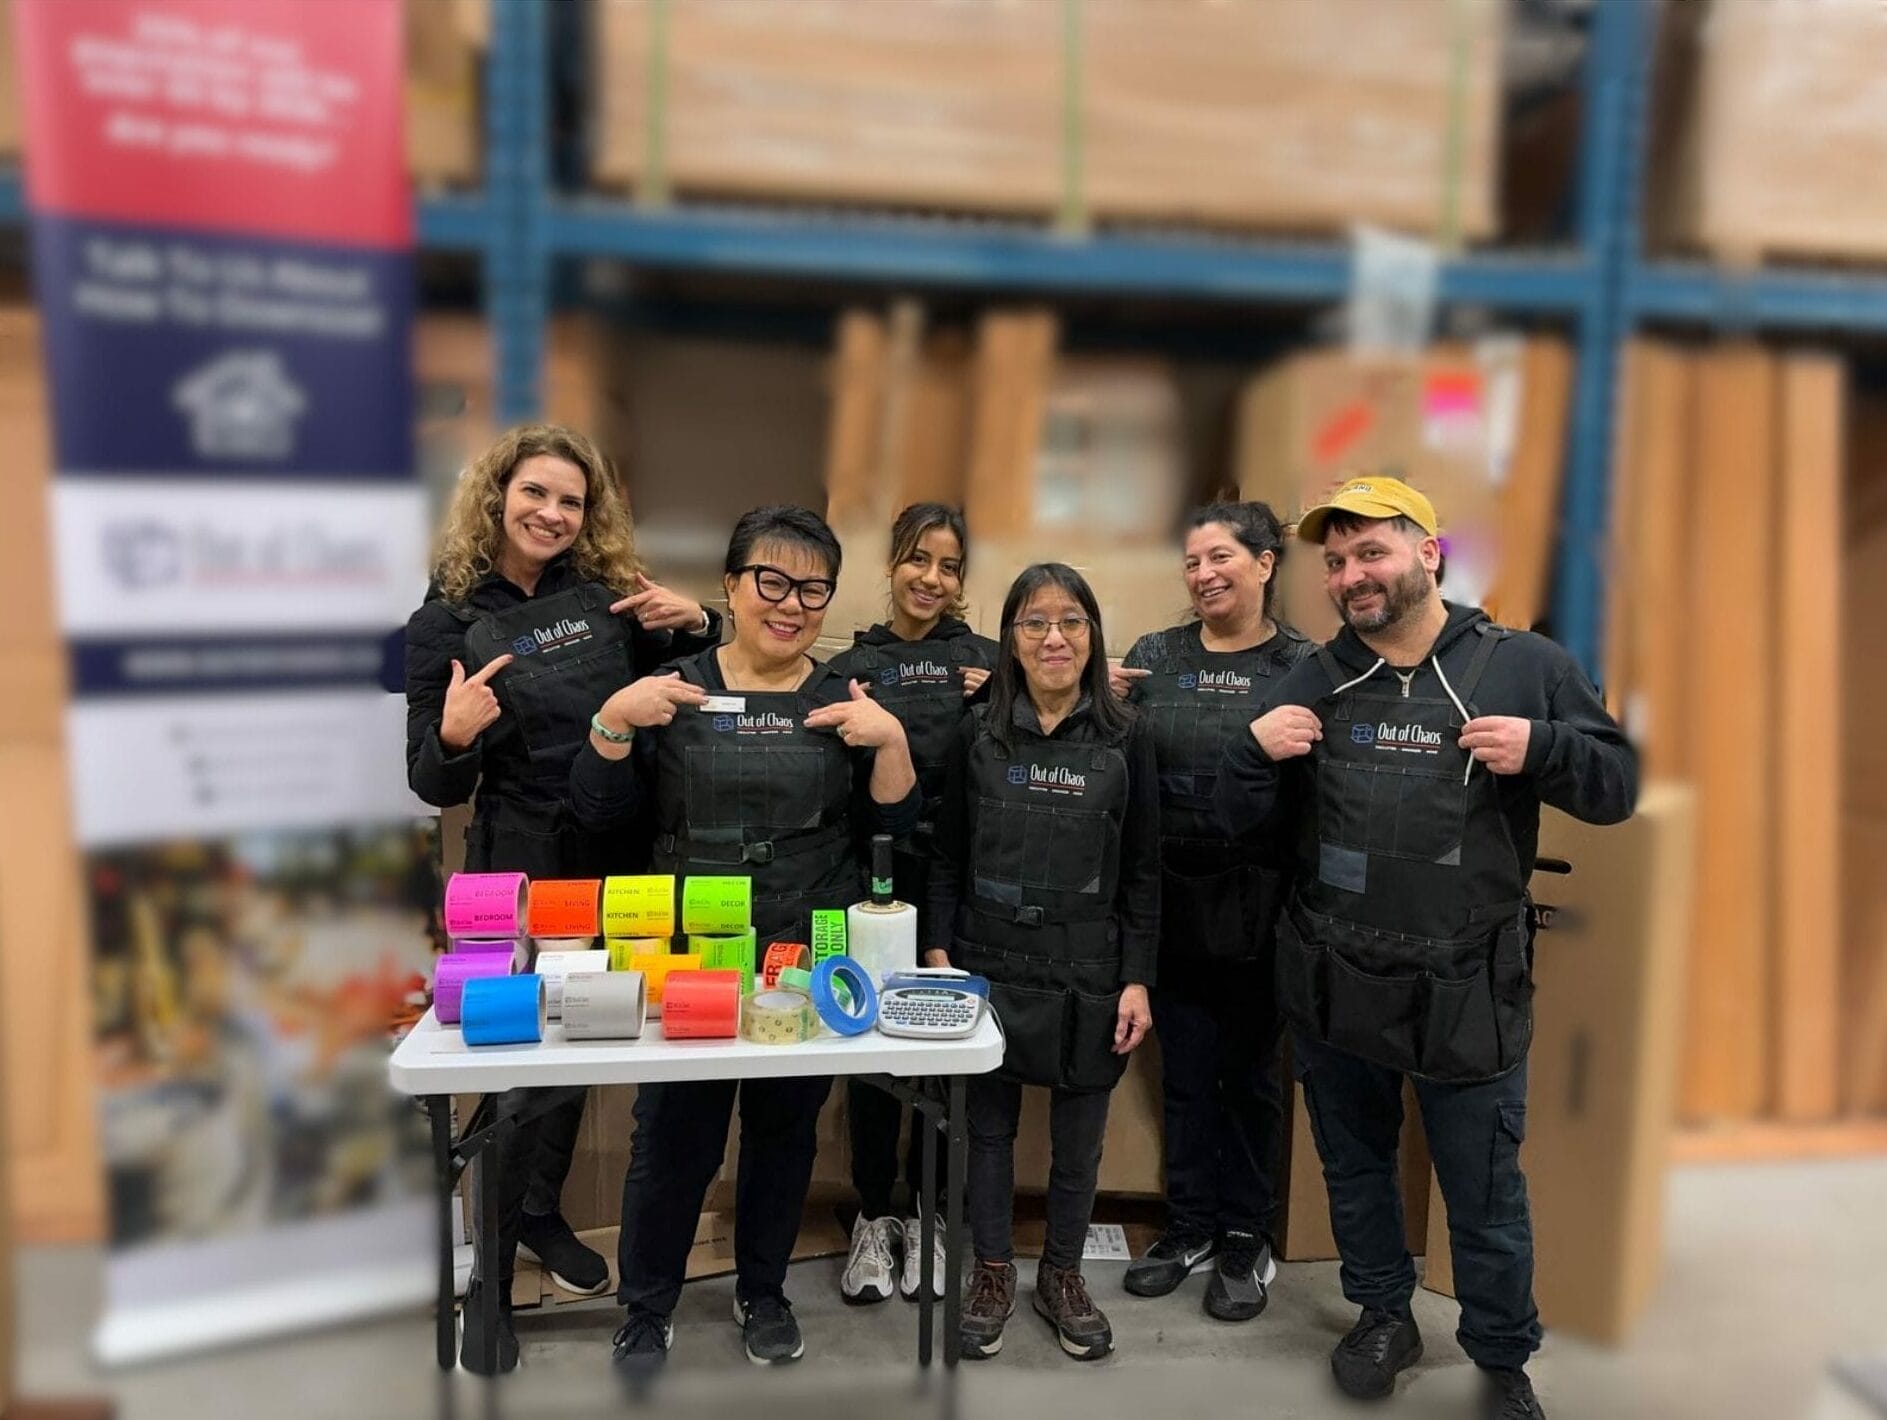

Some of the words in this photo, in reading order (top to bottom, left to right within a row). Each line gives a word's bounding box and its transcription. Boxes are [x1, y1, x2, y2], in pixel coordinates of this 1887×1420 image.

[533, 627, 554, 645] Out
[553, 621, 563, 638] of
[561, 618, 590, 636] Chaos
[899, 662, 915, 678] Out
[915, 661, 924, 676] of
[925, 661, 948, 676] Chaos
[1199, 669, 1215, 684] Out
[1216, 671, 1226, 684] of
[1226, 670, 1251, 687] Chaos
[737, 714, 754, 727] Out
[755, 712, 766, 727] of
[766, 712, 794, 728] Chaos
[1377, 722, 1397, 741] Out
[1398, 723, 1411, 741] of
[1410, 724, 1442, 745] Chaos
[1030, 763, 1047, 782] Out
[1048, 766, 1059, 783] of
[1059, 767, 1086, 787] Chaos
[475, 890, 514, 898] BEDROOM
[474, 913, 514, 922] BEDROOM
[564, 923, 591, 931] LIVING
[830, 922, 844, 952] ONLY
